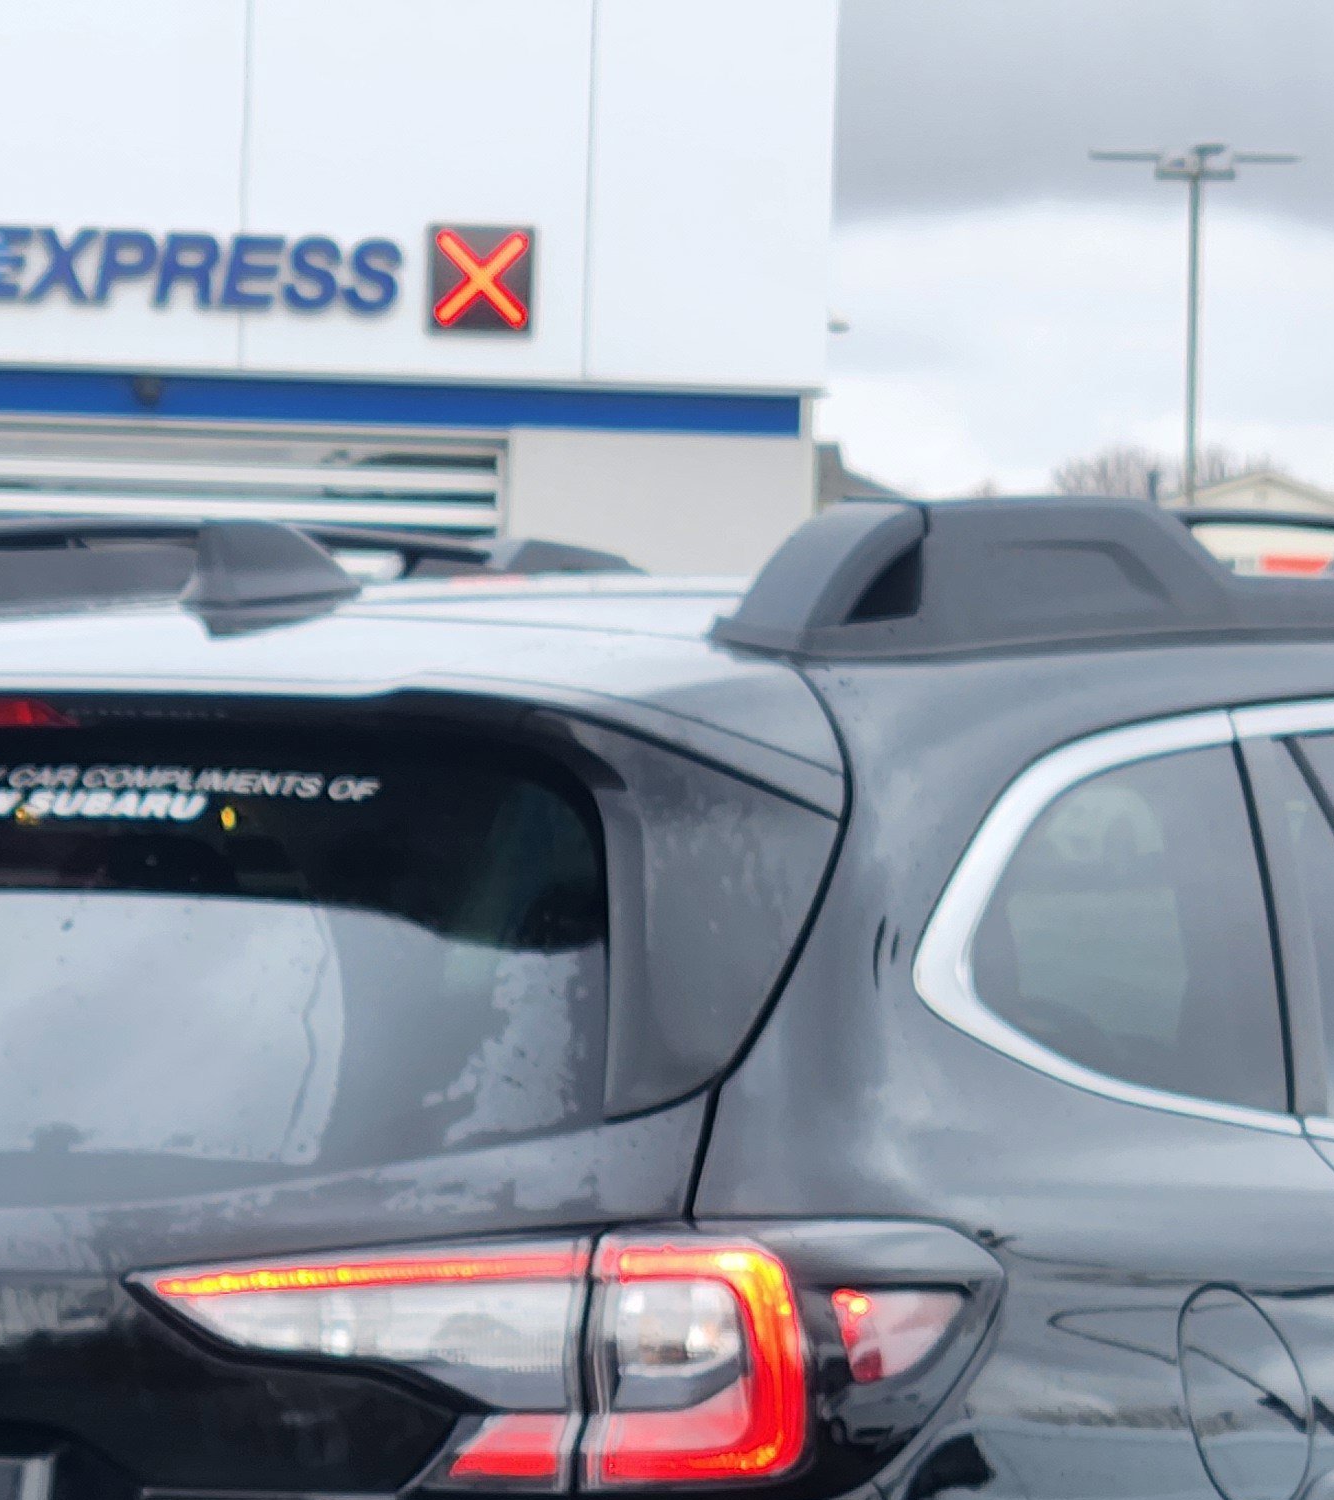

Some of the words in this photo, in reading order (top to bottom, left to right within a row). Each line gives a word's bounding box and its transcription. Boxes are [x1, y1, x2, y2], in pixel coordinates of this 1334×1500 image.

[8, 765, 79, 788] CAR
[82, 765, 323, 798] COMPLIMENTS
[327, 775, 380, 801] OF
[21, 789, 208, 820] SUBARU
